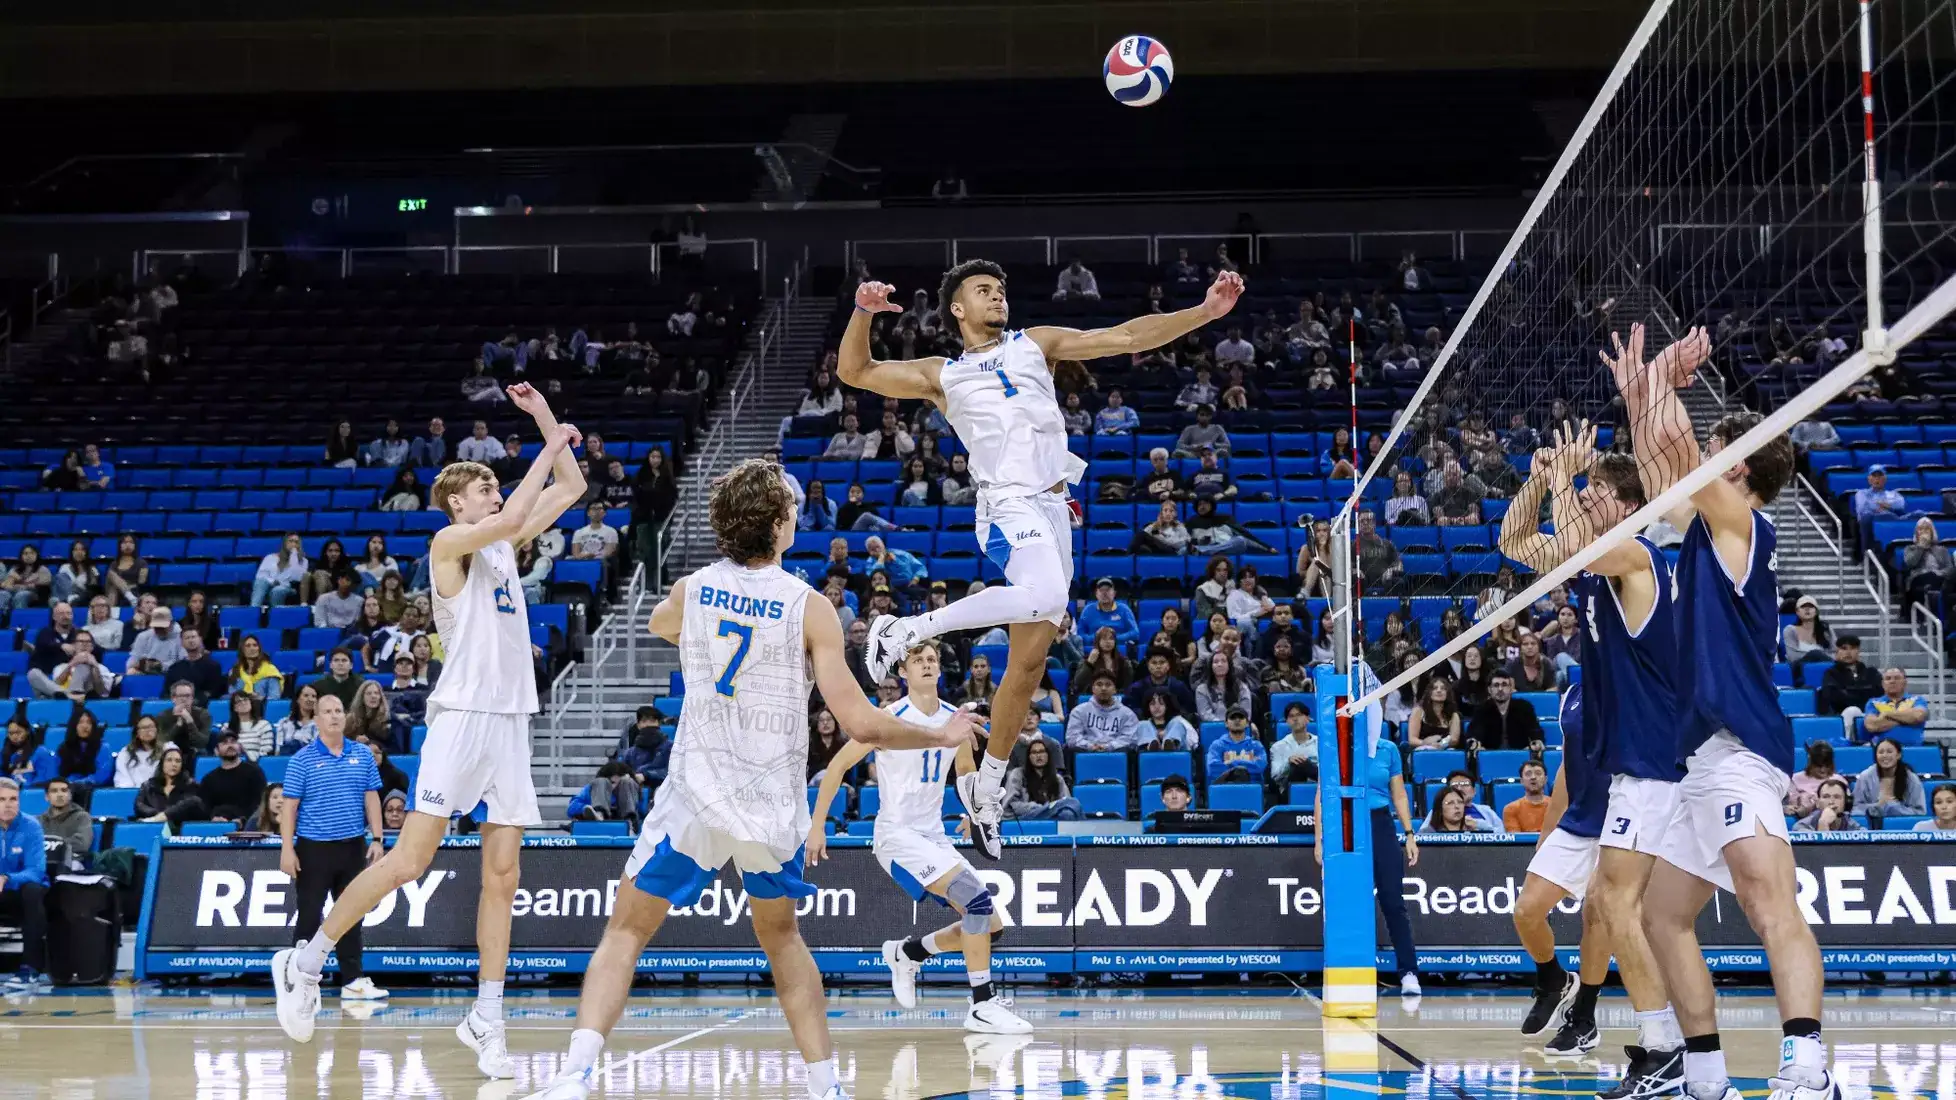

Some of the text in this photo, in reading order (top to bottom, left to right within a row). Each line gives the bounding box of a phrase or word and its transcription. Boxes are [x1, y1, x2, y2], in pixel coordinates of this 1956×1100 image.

[399, 199, 427, 211] EXIT
[996, 369, 1019, 399] 1
[700, 586, 784, 619] BRUINS
[715, 616, 756, 700] 7
[1087, 712, 1121, 734] UCLA
[920, 749, 942, 783] 11
[1725, 803, 1743, 826] 9
[1611, 817, 1632, 836] 3
[1239, 835, 1279, 844] WESCOM
[1413, 833, 1459, 843] presented
[1461, 833, 1472, 843] by
[1476, 833, 1516, 842] WESCOM
[976, 868, 1224, 927] READY
[199, 957, 243, 966] PAVILION
[420, 957, 464, 966] PAVILION
[514, 957, 525, 969] by
[527, 957, 566, 967] WESCOM
[709, 958, 753, 969] presented
[756, 957, 767, 969] by
[991, 957, 1003, 968] by
[1006, 957, 1046, 966] WESCOM
[1178, 955, 1224, 967] presented
[1226, 954, 1238, 967] by
[1240, 954, 1281, 964] WESCOM
[1465, 953, 1477, 966] by
[1479, 954, 1521, 964] WESCOM
[1720, 955, 1762, 965] WESCOM
[1887, 954, 1935, 966] presented
[1937, 953, 1950, 966] by
